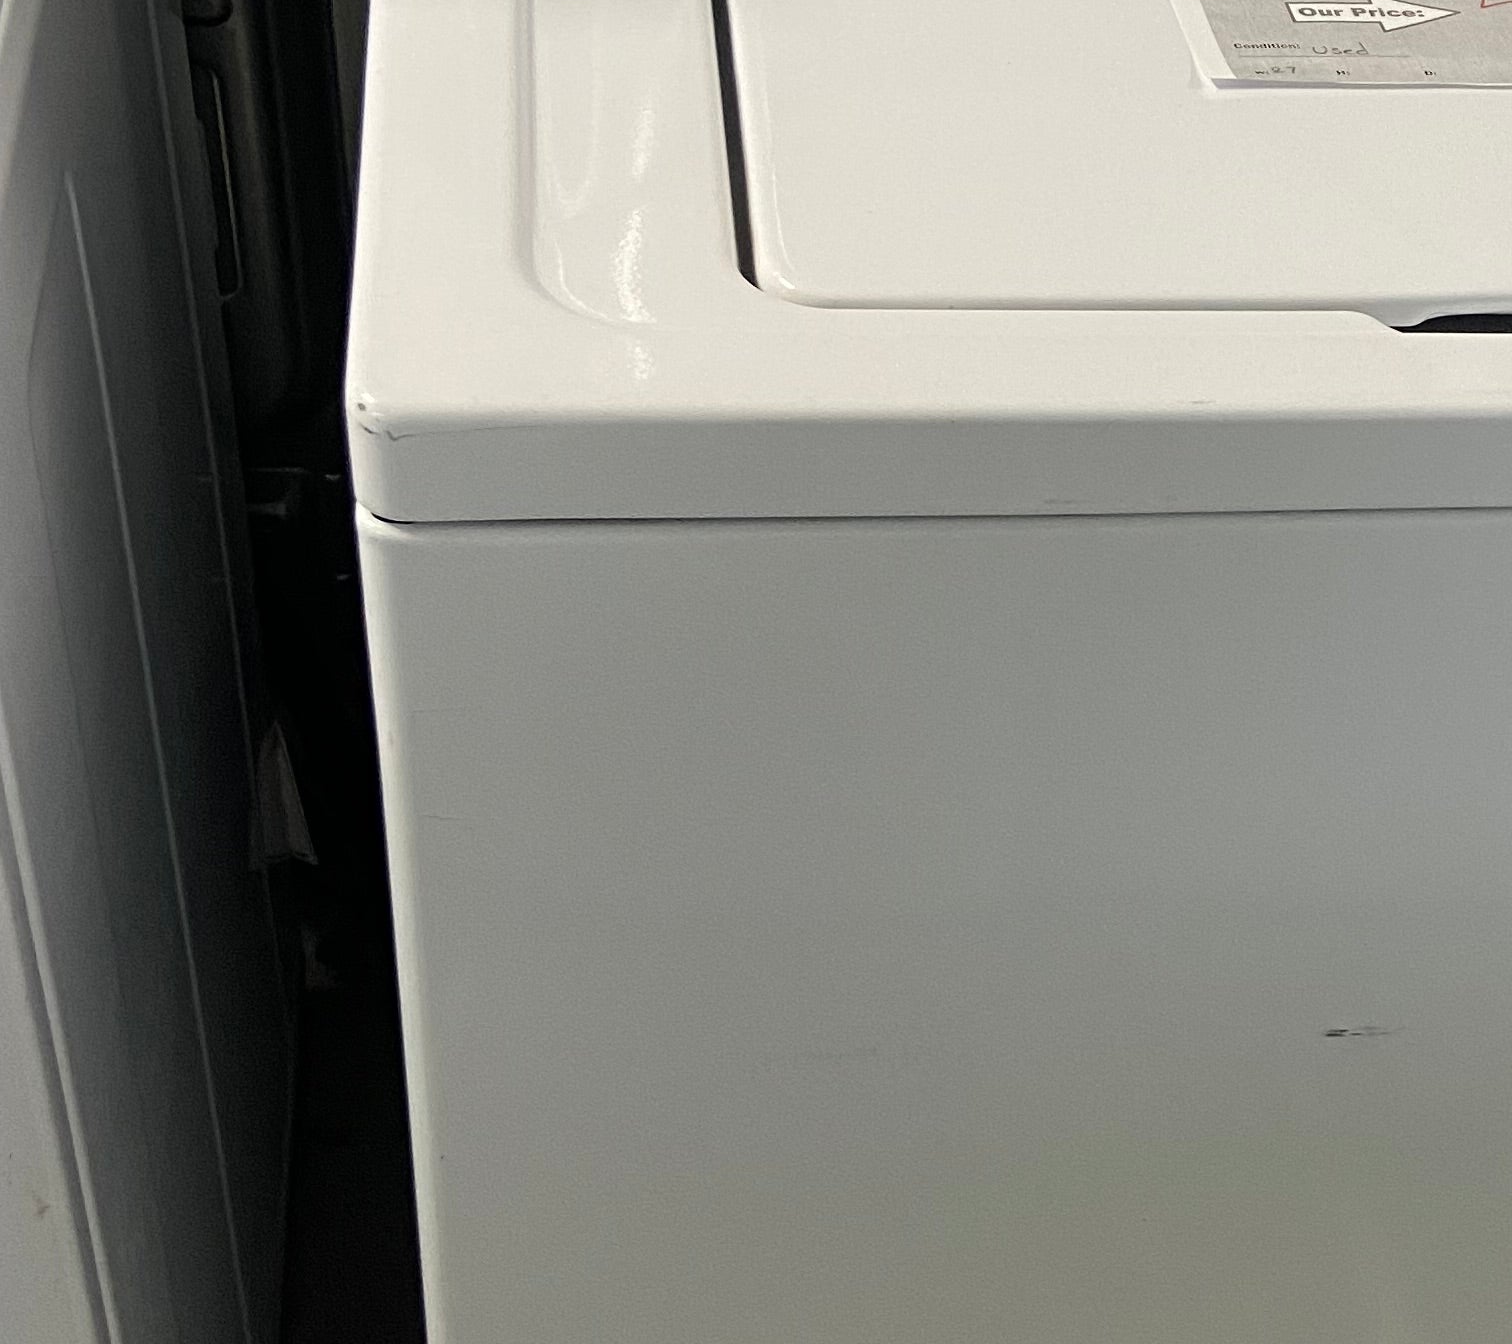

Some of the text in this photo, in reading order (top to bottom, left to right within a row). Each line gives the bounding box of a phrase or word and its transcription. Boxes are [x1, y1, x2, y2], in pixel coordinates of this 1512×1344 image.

[1298, 7, 1425, 18] Our Price:
[1233, 42, 1301, 50] Condition:
[1311, 42, 1369, 56] Used
